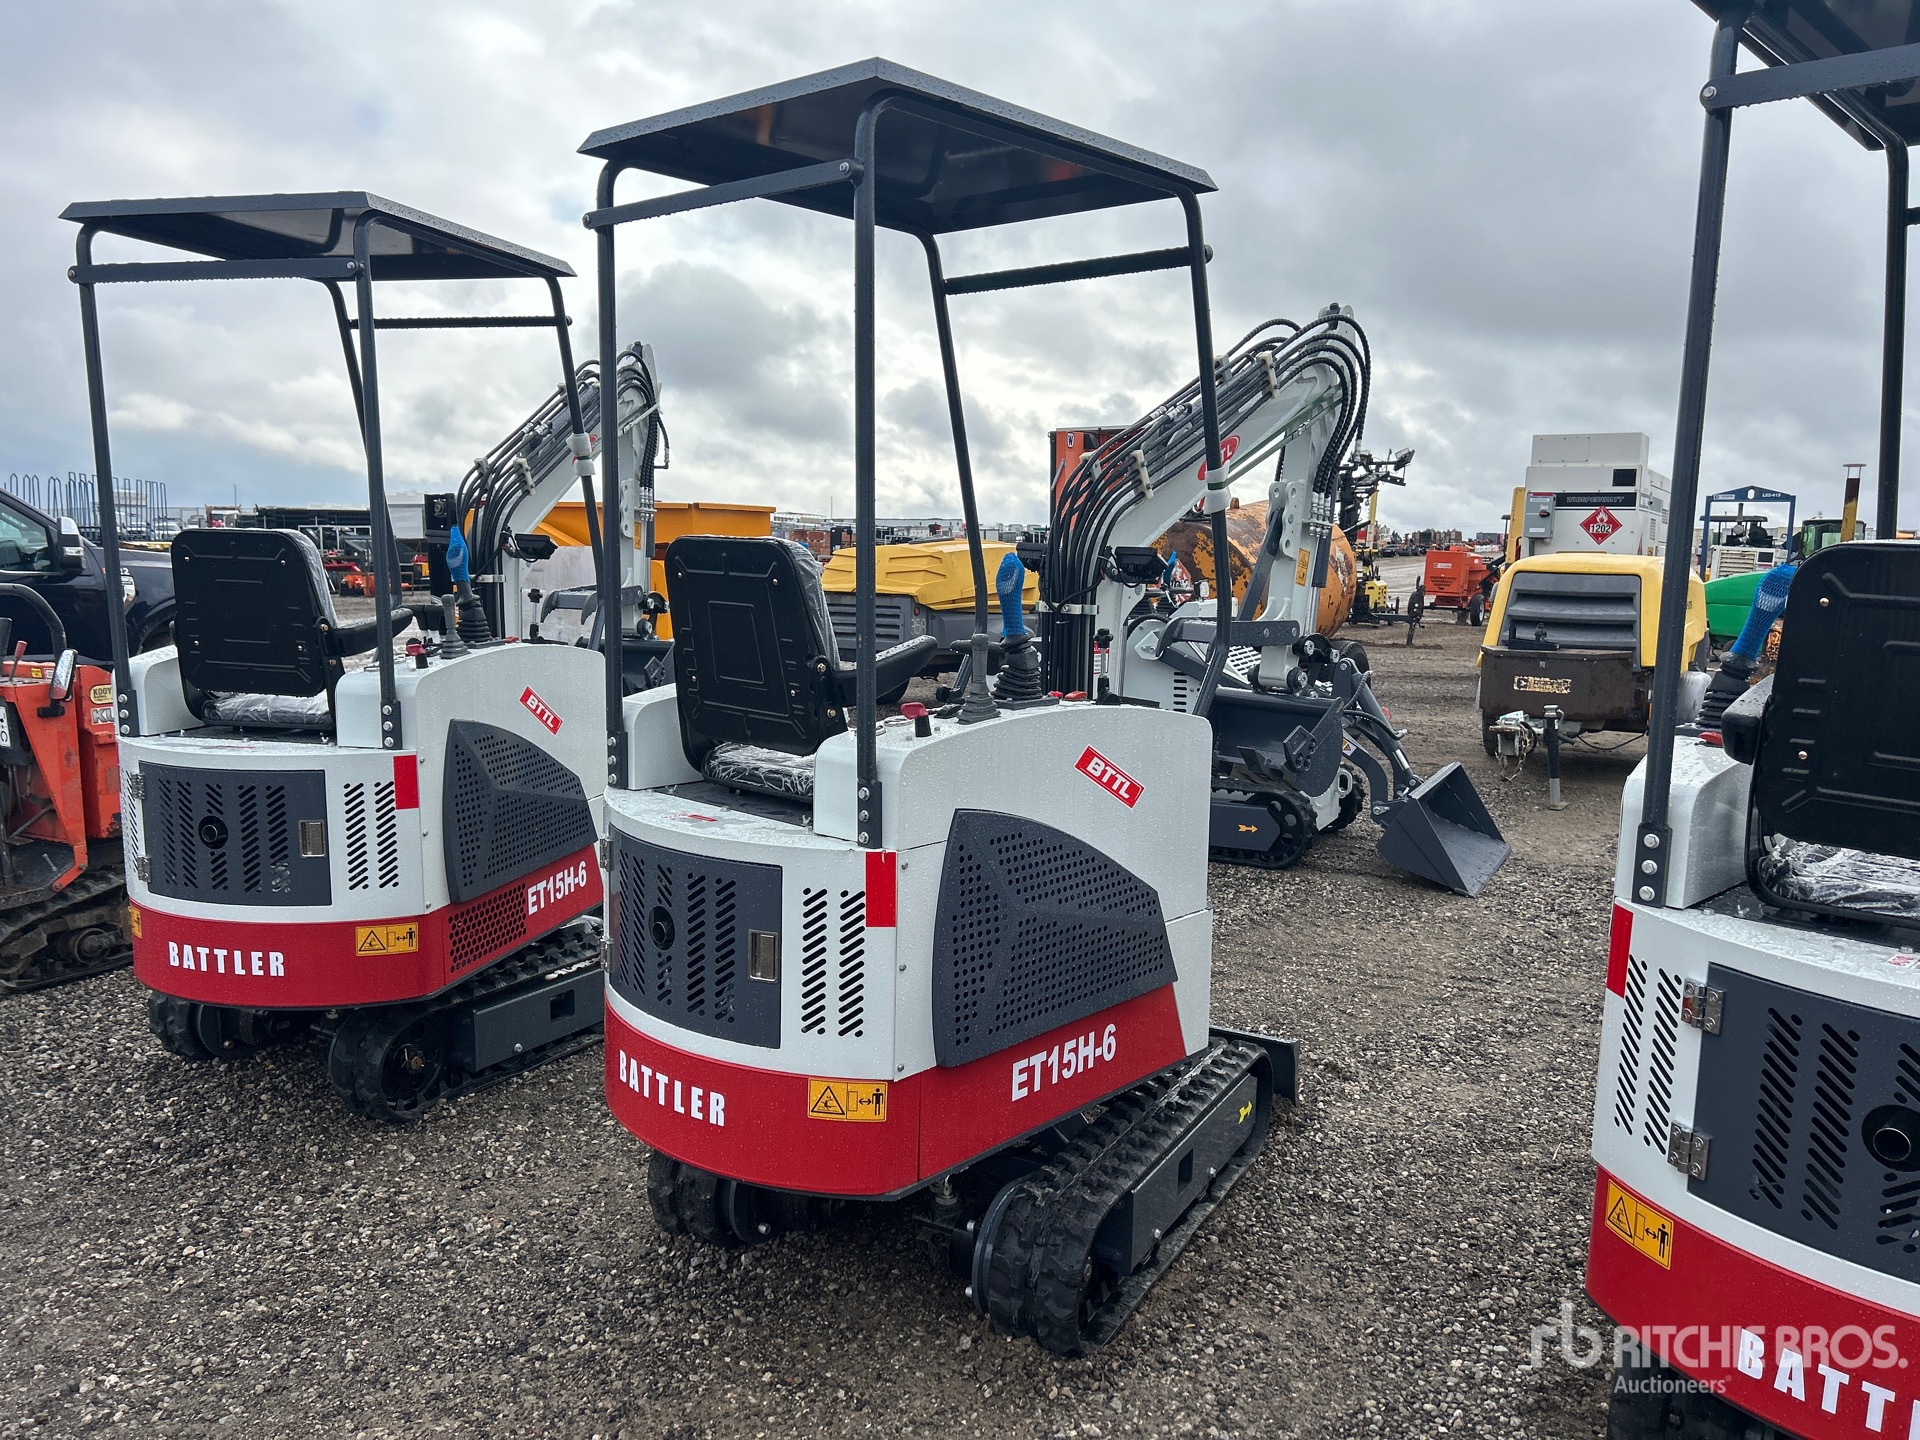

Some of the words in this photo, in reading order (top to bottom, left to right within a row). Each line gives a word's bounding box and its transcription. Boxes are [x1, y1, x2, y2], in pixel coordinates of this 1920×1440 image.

[1590, 524, 1611, 533] 1202
[93, 686, 112, 698] KOOY
[526, 694, 555, 728] BTTL
[1086, 756, 1131, 799] BTTL
[527, 860, 587, 916] ET15H-6
[168, 941, 285, 977] BATTLER
[1011, 1023, 1117, 1103] ET15H-6
[619, 1049, 725, 1127] BATTLER
